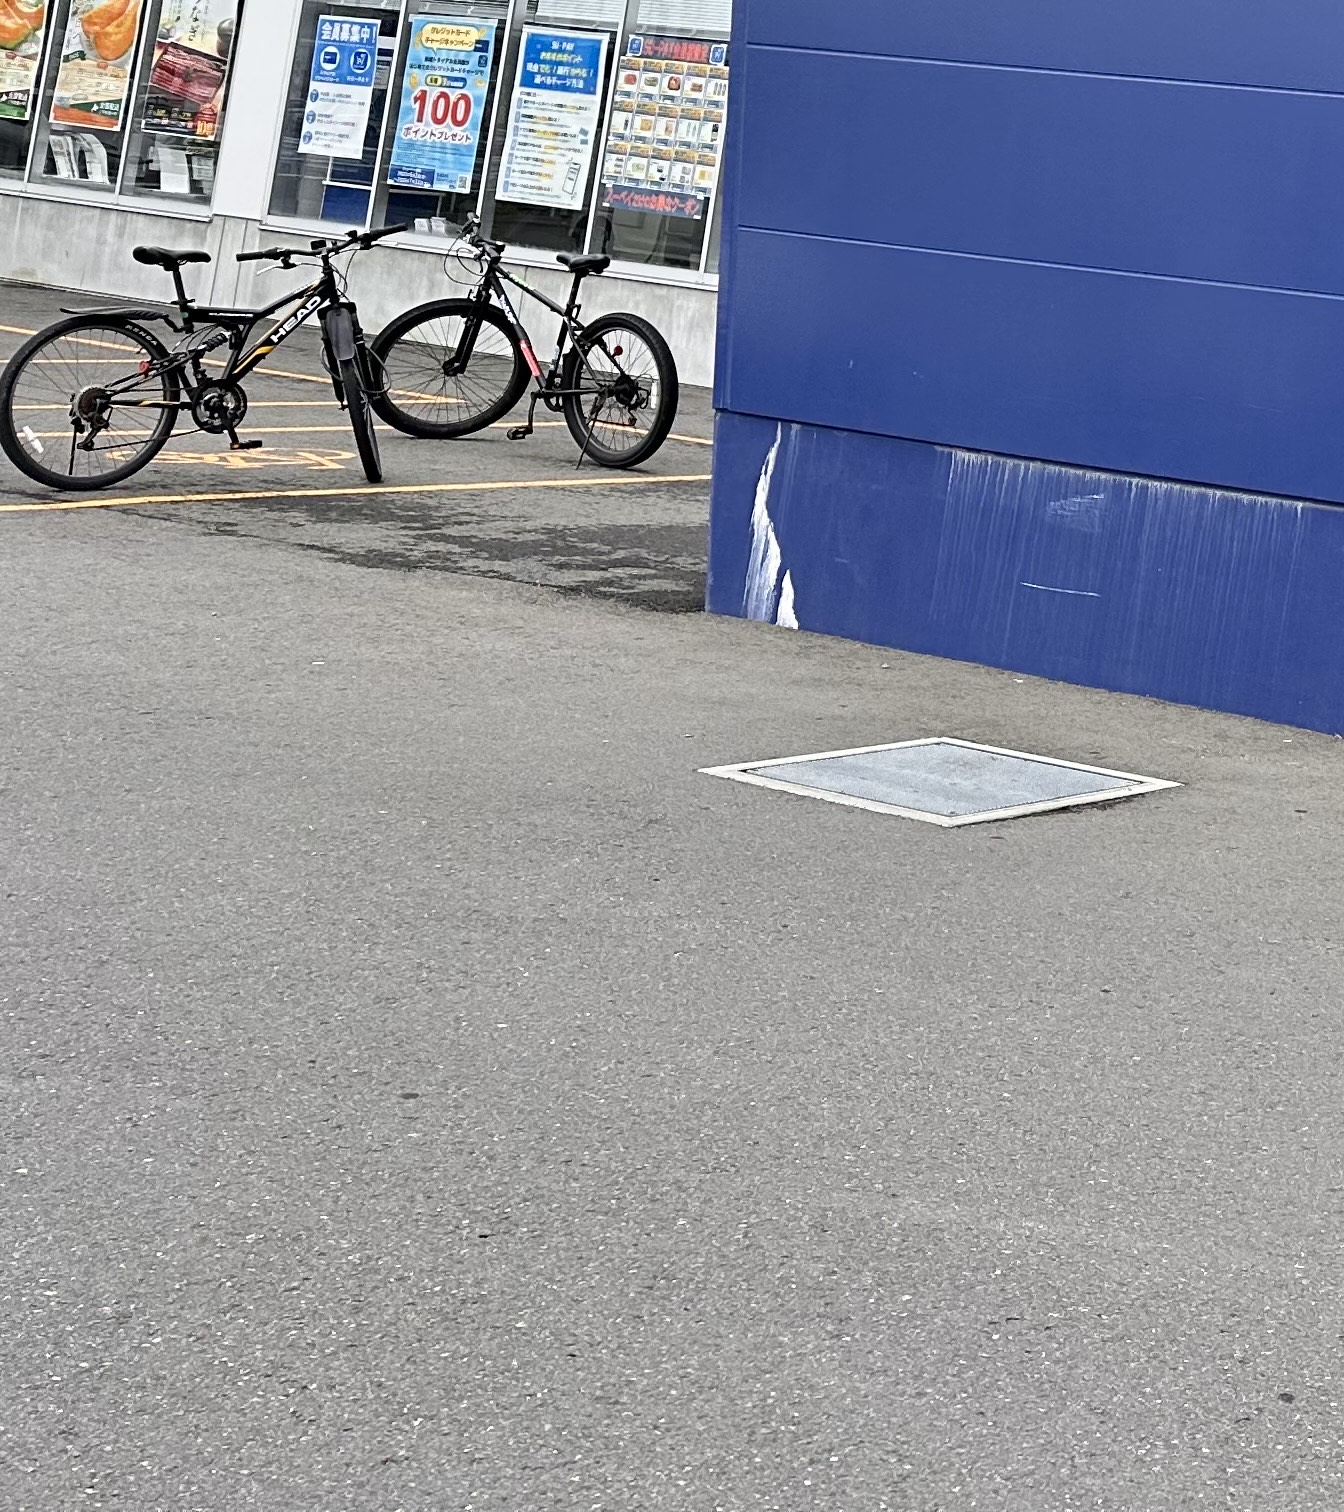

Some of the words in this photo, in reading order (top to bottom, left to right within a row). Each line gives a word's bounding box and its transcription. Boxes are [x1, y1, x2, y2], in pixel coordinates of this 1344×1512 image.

[413, 89, 472, 128] 100
[403, 126, 472, 142] ポイントプレゼント
[270, 296, 321, 343] HEAD
